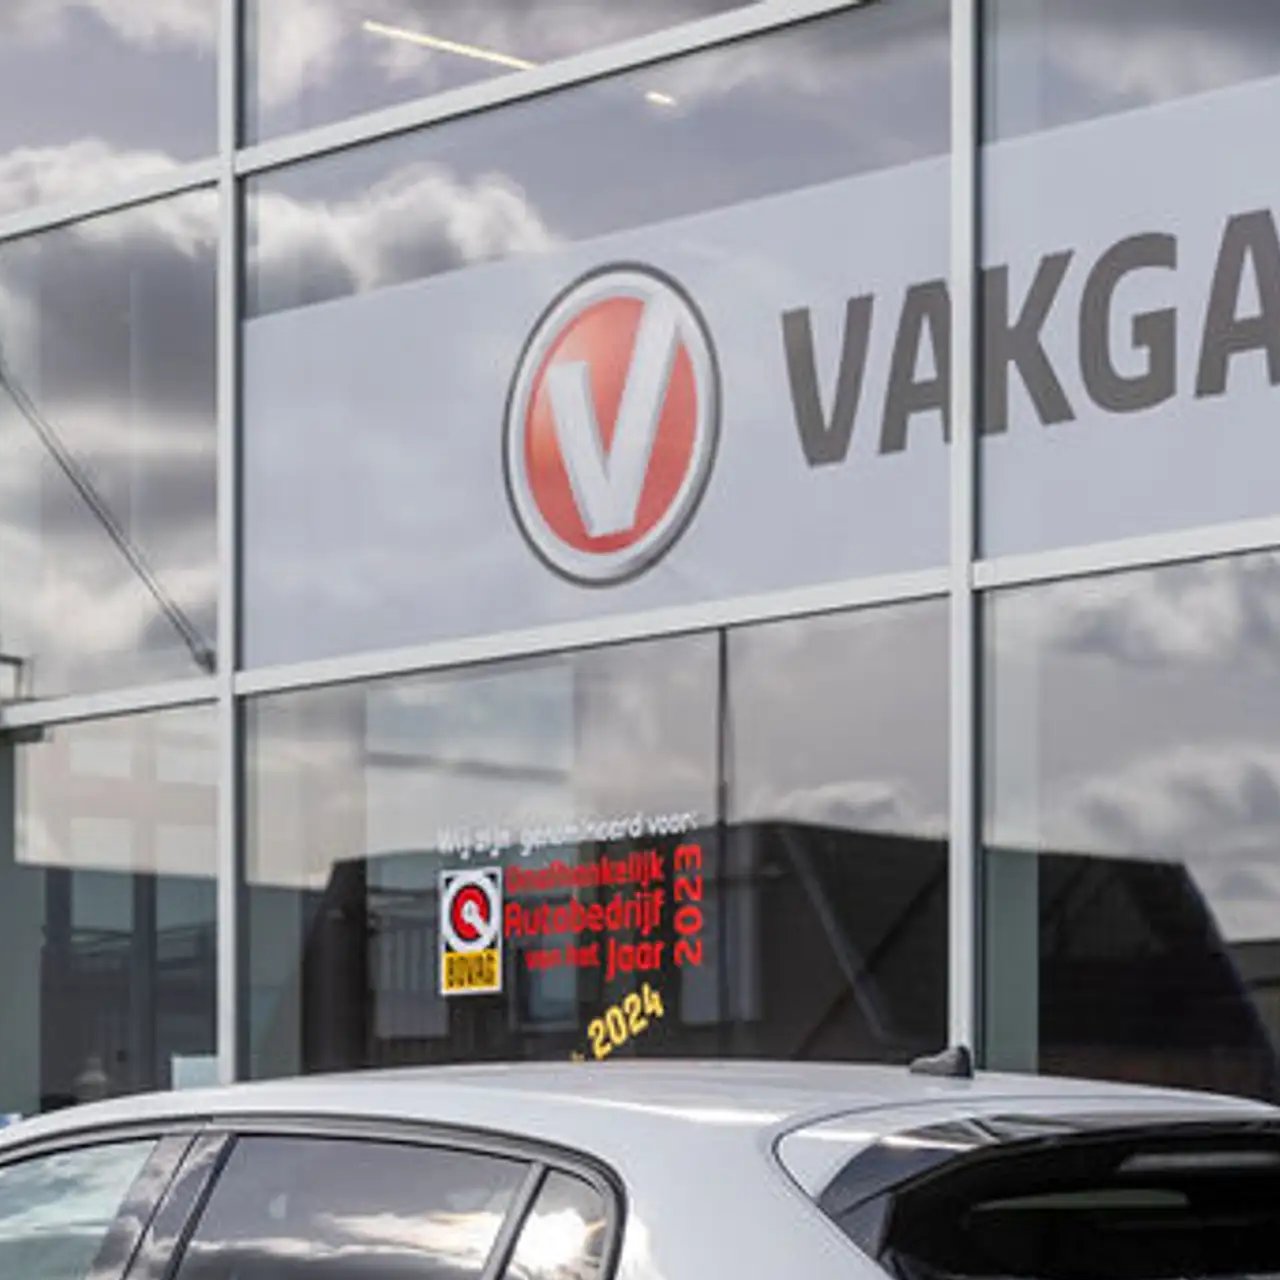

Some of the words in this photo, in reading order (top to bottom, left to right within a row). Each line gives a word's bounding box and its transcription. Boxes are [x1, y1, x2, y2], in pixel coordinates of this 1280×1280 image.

[505, 889, 665, 940] Autobedrijf
[674, 844, 703, 967] 2023
[588, 982, 664, 1060] 2024
